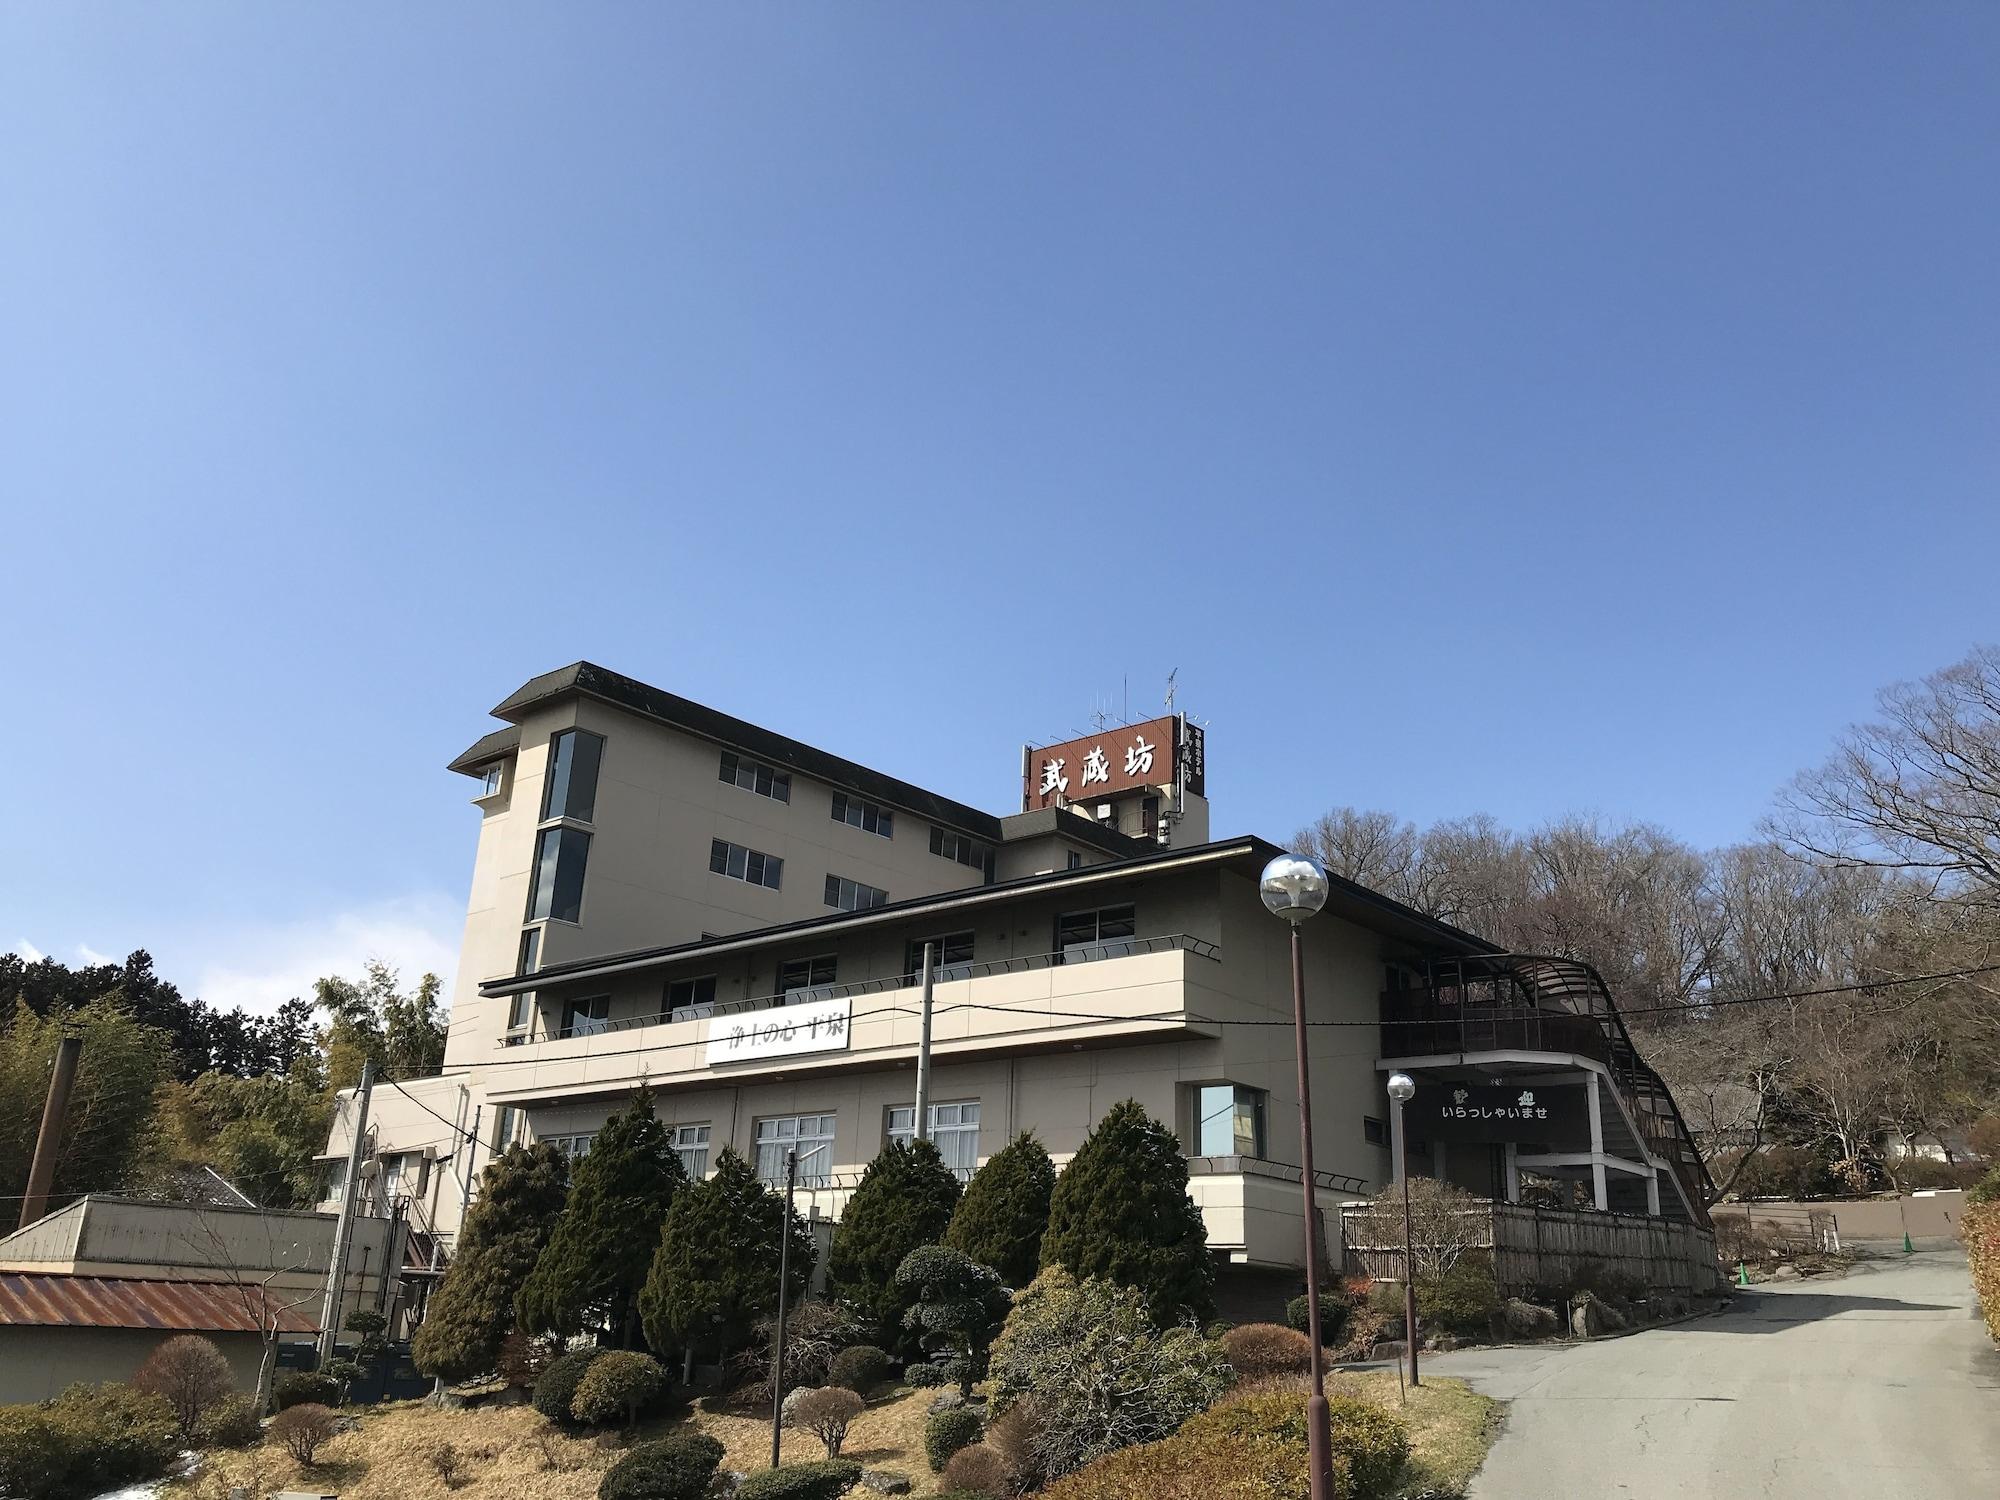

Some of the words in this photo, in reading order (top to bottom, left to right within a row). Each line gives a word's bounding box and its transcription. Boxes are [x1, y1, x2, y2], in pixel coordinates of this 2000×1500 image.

[1039, 735, 1156, 796] 武蔵坊
[1442, 1106, 1548, 1119] いらっしゃいませ
